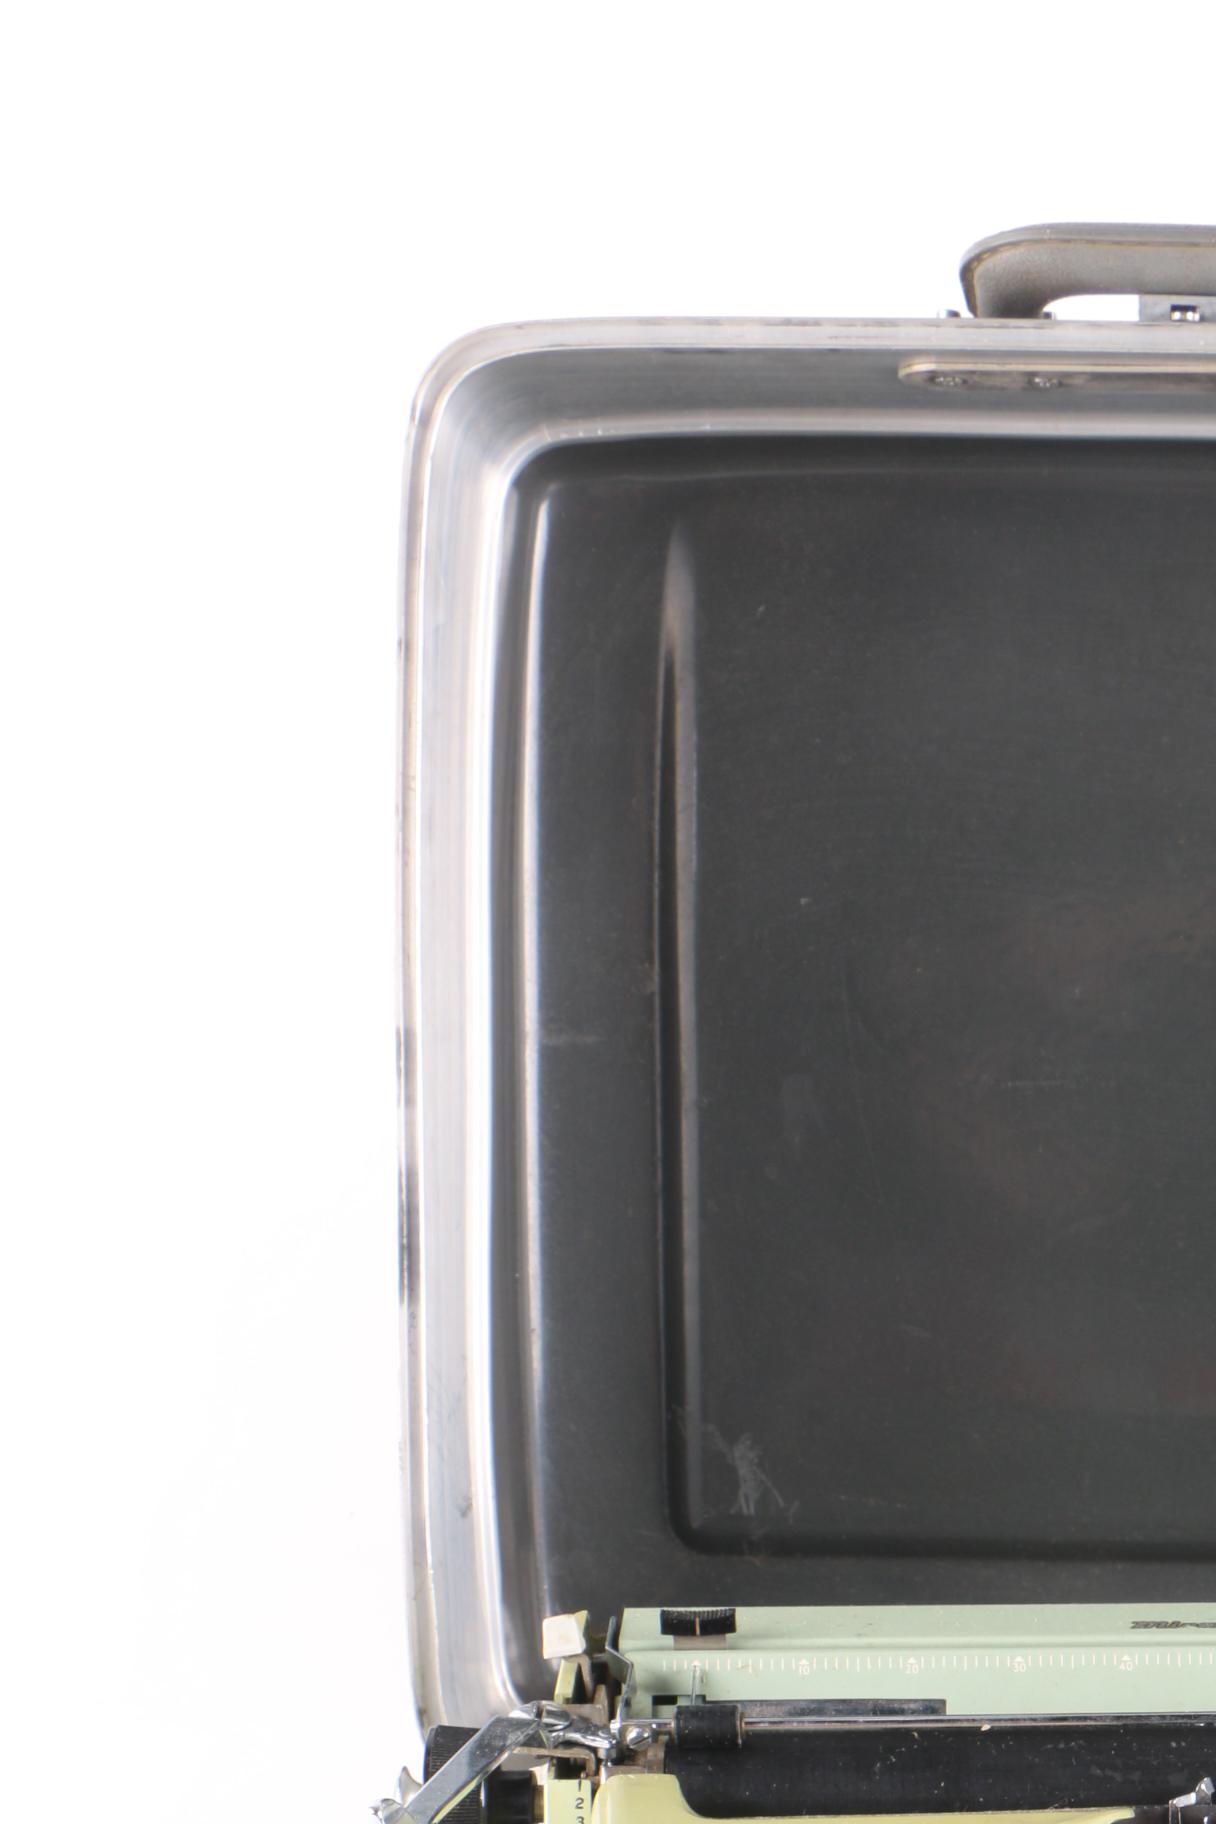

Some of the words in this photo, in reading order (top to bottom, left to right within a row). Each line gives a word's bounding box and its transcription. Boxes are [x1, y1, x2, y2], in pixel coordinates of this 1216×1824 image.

[798, 1664, 810, 1676] 10
[905, 1663, 920, 1675] 20
[1011, 1662, 1027, 1673] 30
[1118, 1661, 1134, 1672] 40
[575, 1797, 584, 1809] 2
